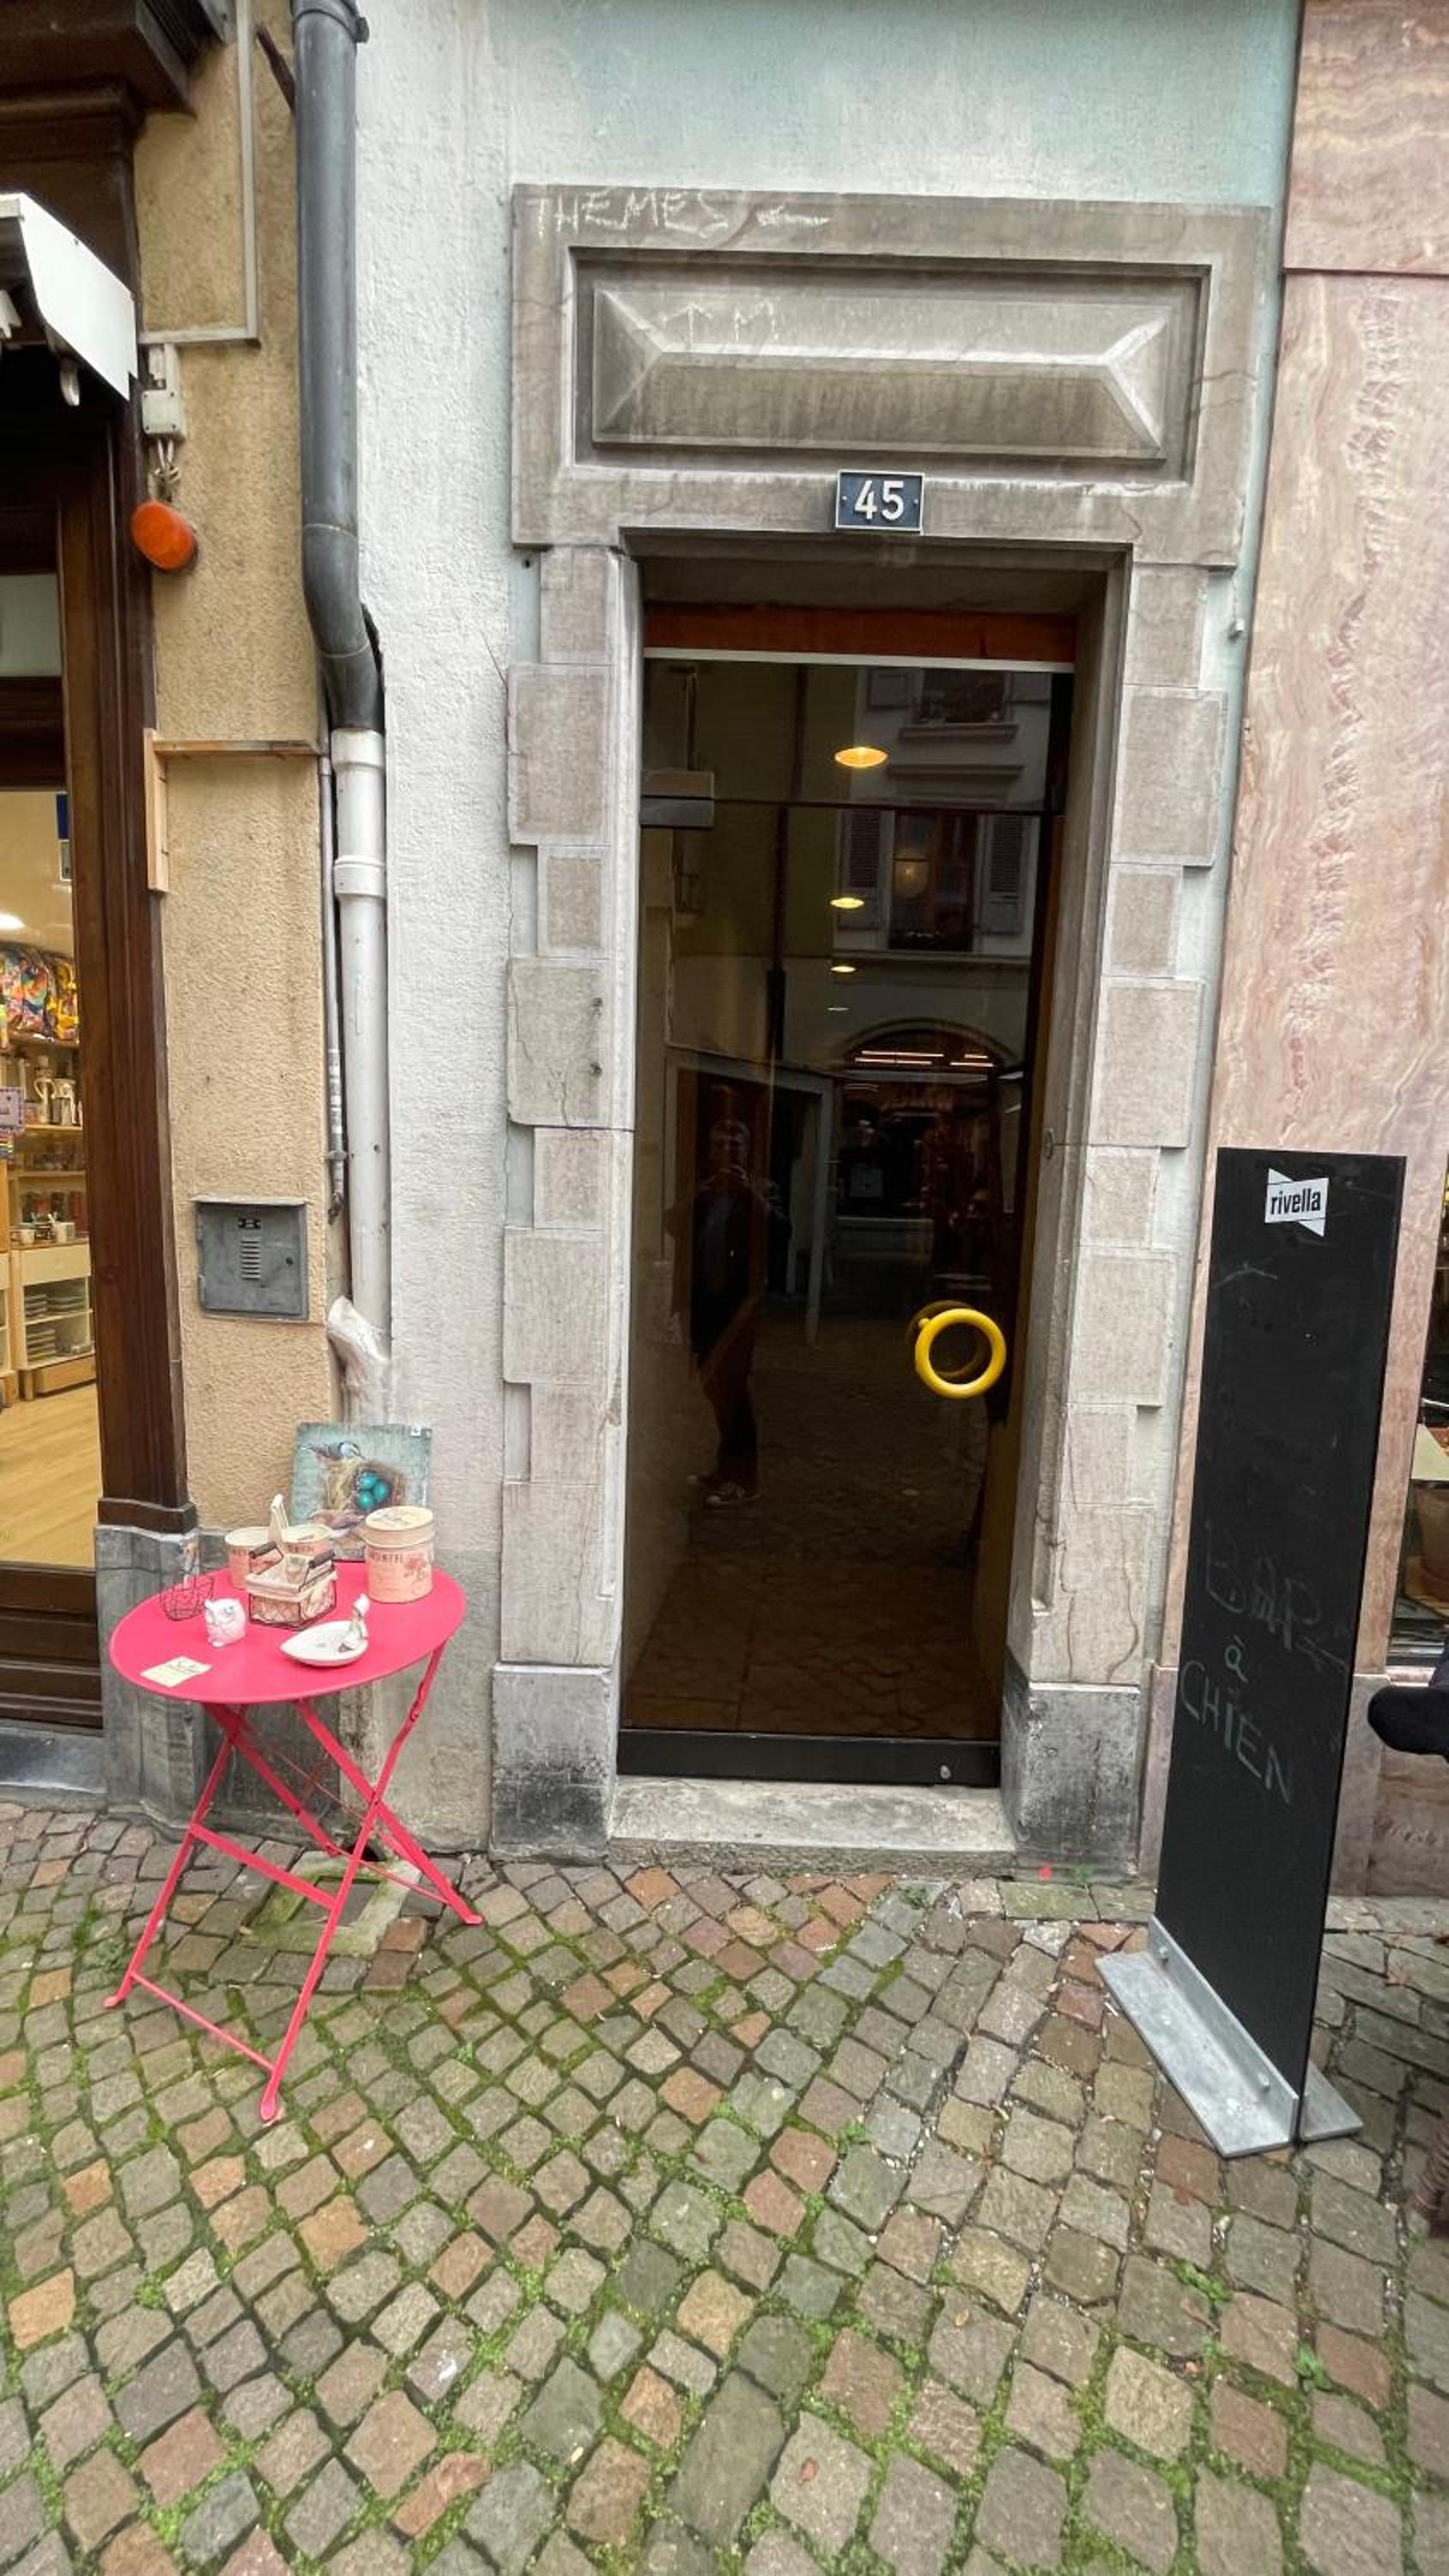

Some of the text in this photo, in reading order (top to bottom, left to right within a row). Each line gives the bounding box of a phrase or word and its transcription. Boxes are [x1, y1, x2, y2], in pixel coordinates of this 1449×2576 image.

[854, 479, 904, 520] 45
[1270, 1188, 1321, 1215] rivella
[1180, 1660, 1289, 1804] CHIEN
